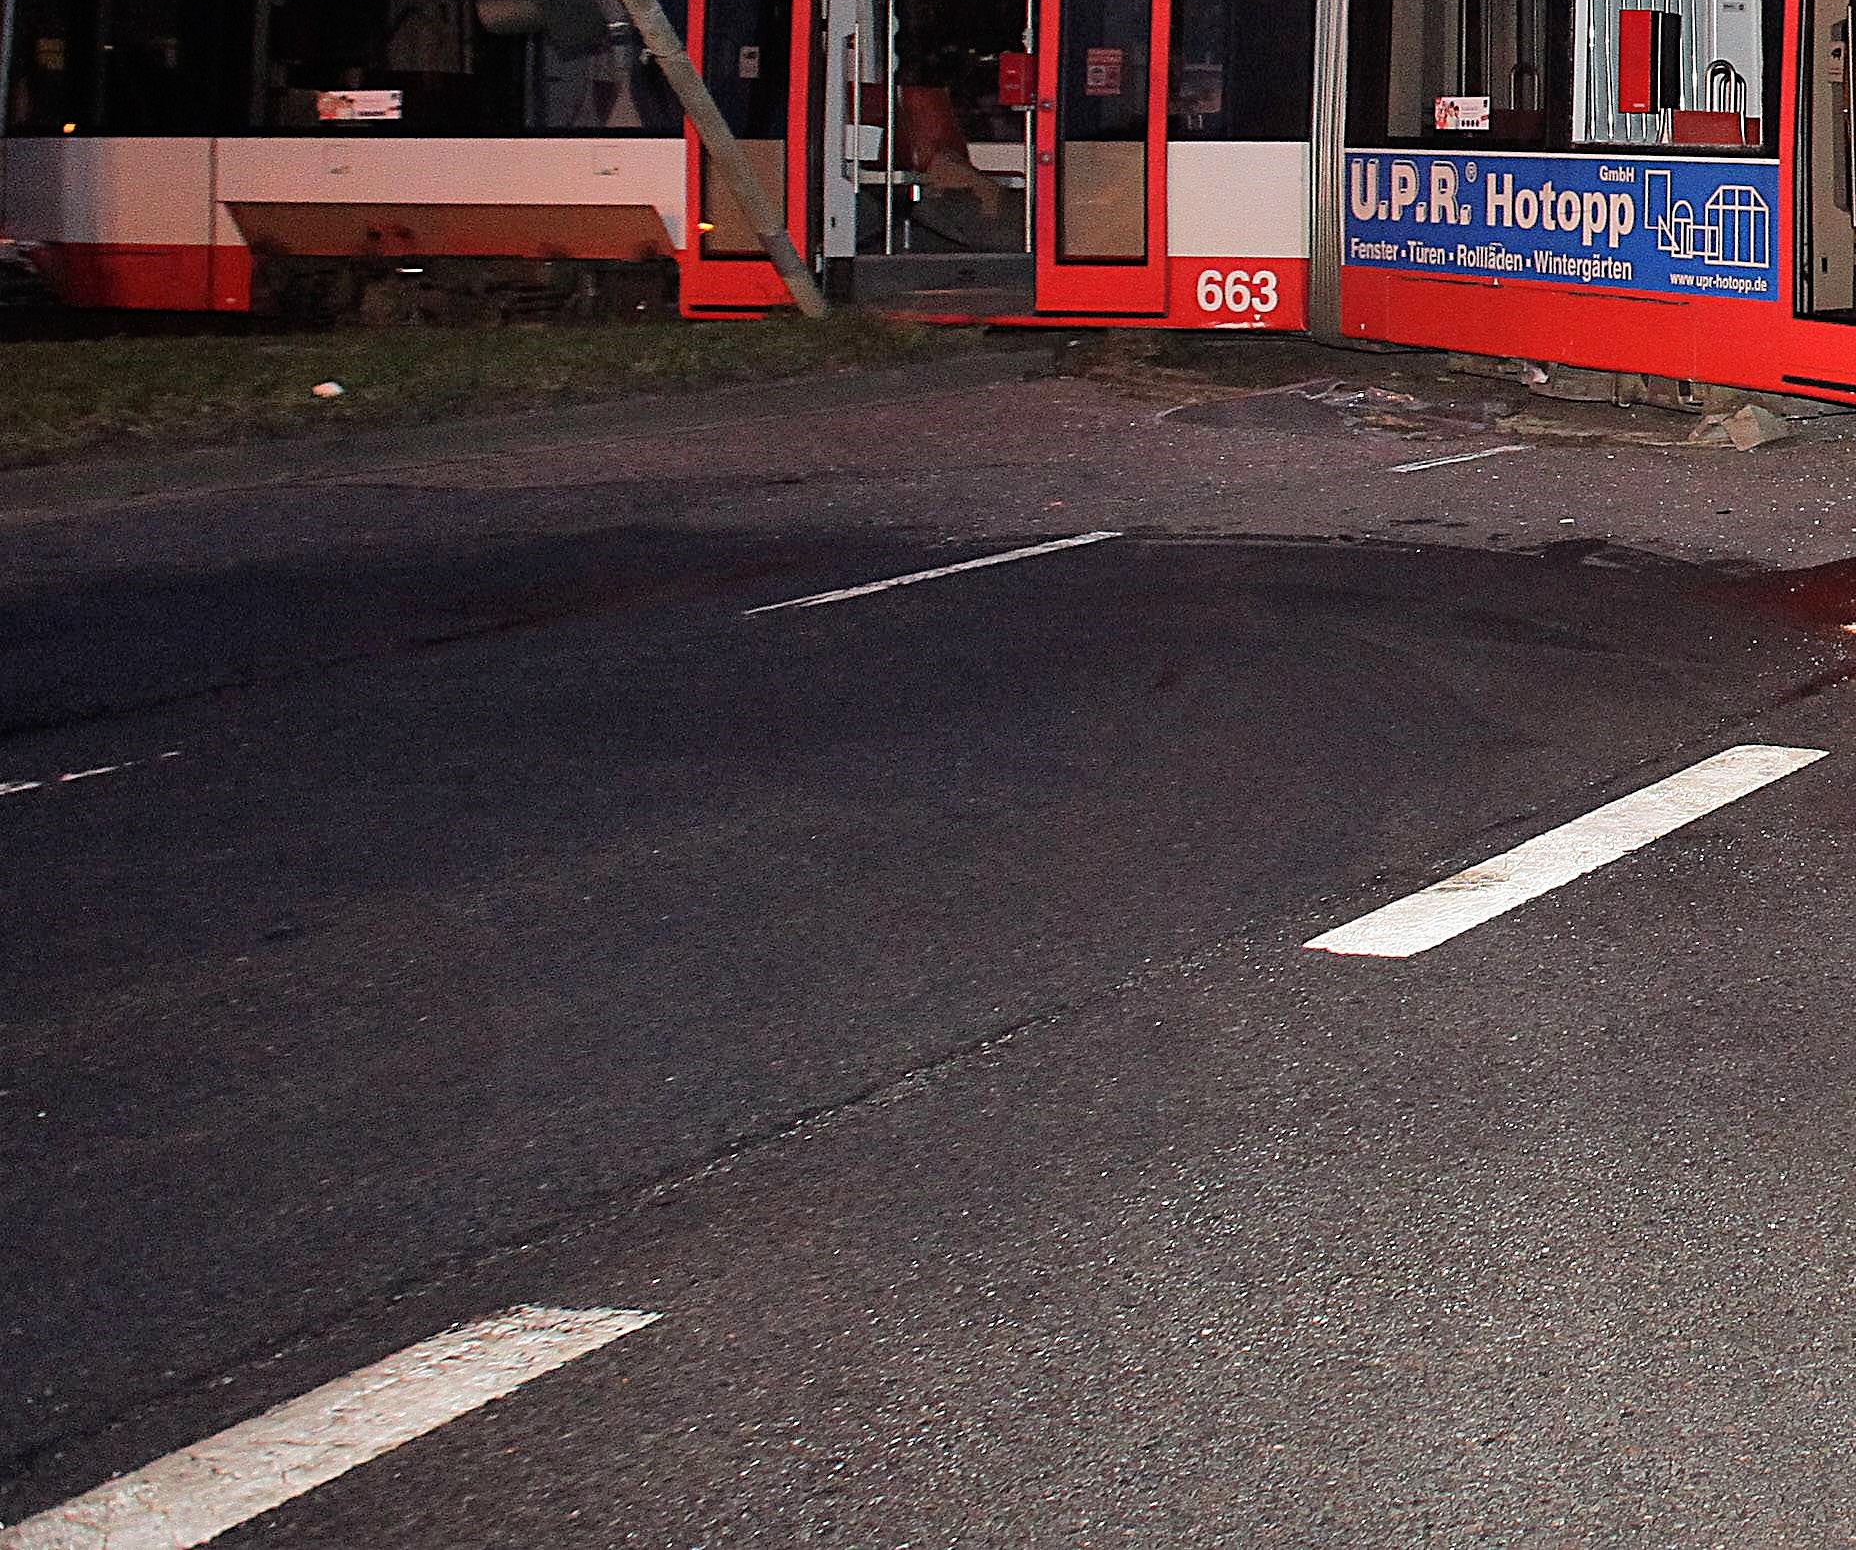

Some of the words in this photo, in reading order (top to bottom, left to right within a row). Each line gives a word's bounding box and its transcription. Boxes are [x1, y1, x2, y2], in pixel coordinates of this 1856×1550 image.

[1600, 165, 1635, 182] GmbH
[1486, 173, 1635, 248] Hotopp
[1350, 237, 1398, 262] Fenster
[1407, 240, 1445, 265] Türen
[1457, 243, 1523, 272] Rollläden
[1534, 250, 1632, 283] Wintergärten
[1196, 270, 1278, 313] 663
